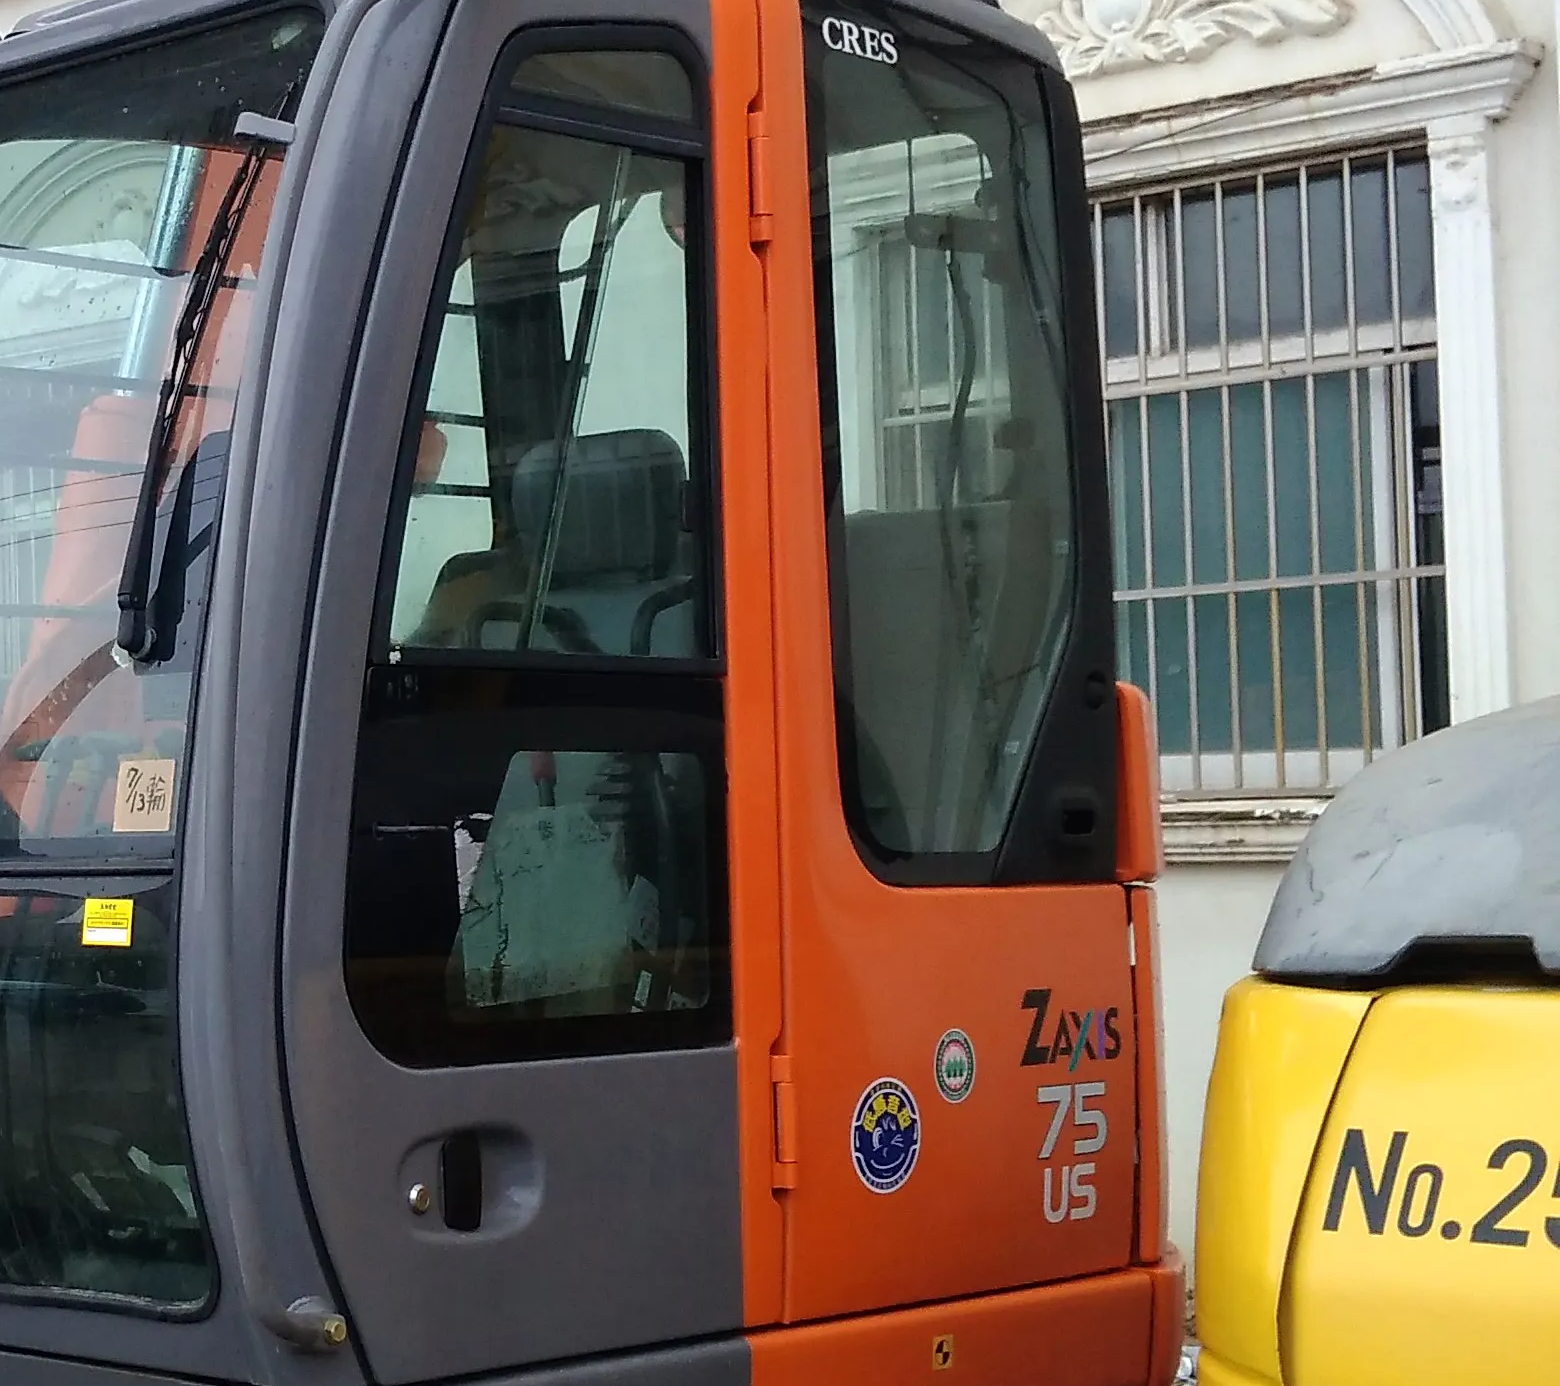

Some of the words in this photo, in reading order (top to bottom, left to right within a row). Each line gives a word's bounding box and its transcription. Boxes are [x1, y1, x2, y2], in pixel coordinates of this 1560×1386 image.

[823, 17, 897, 64] CRES
[1020, 988, 1120, 1072] ZAXIS
[1037, 1080, 1108, 1160] 75
[1043, 1163, 1096, 1223] US
[1322, 1128, 1560, 1248] No.2
